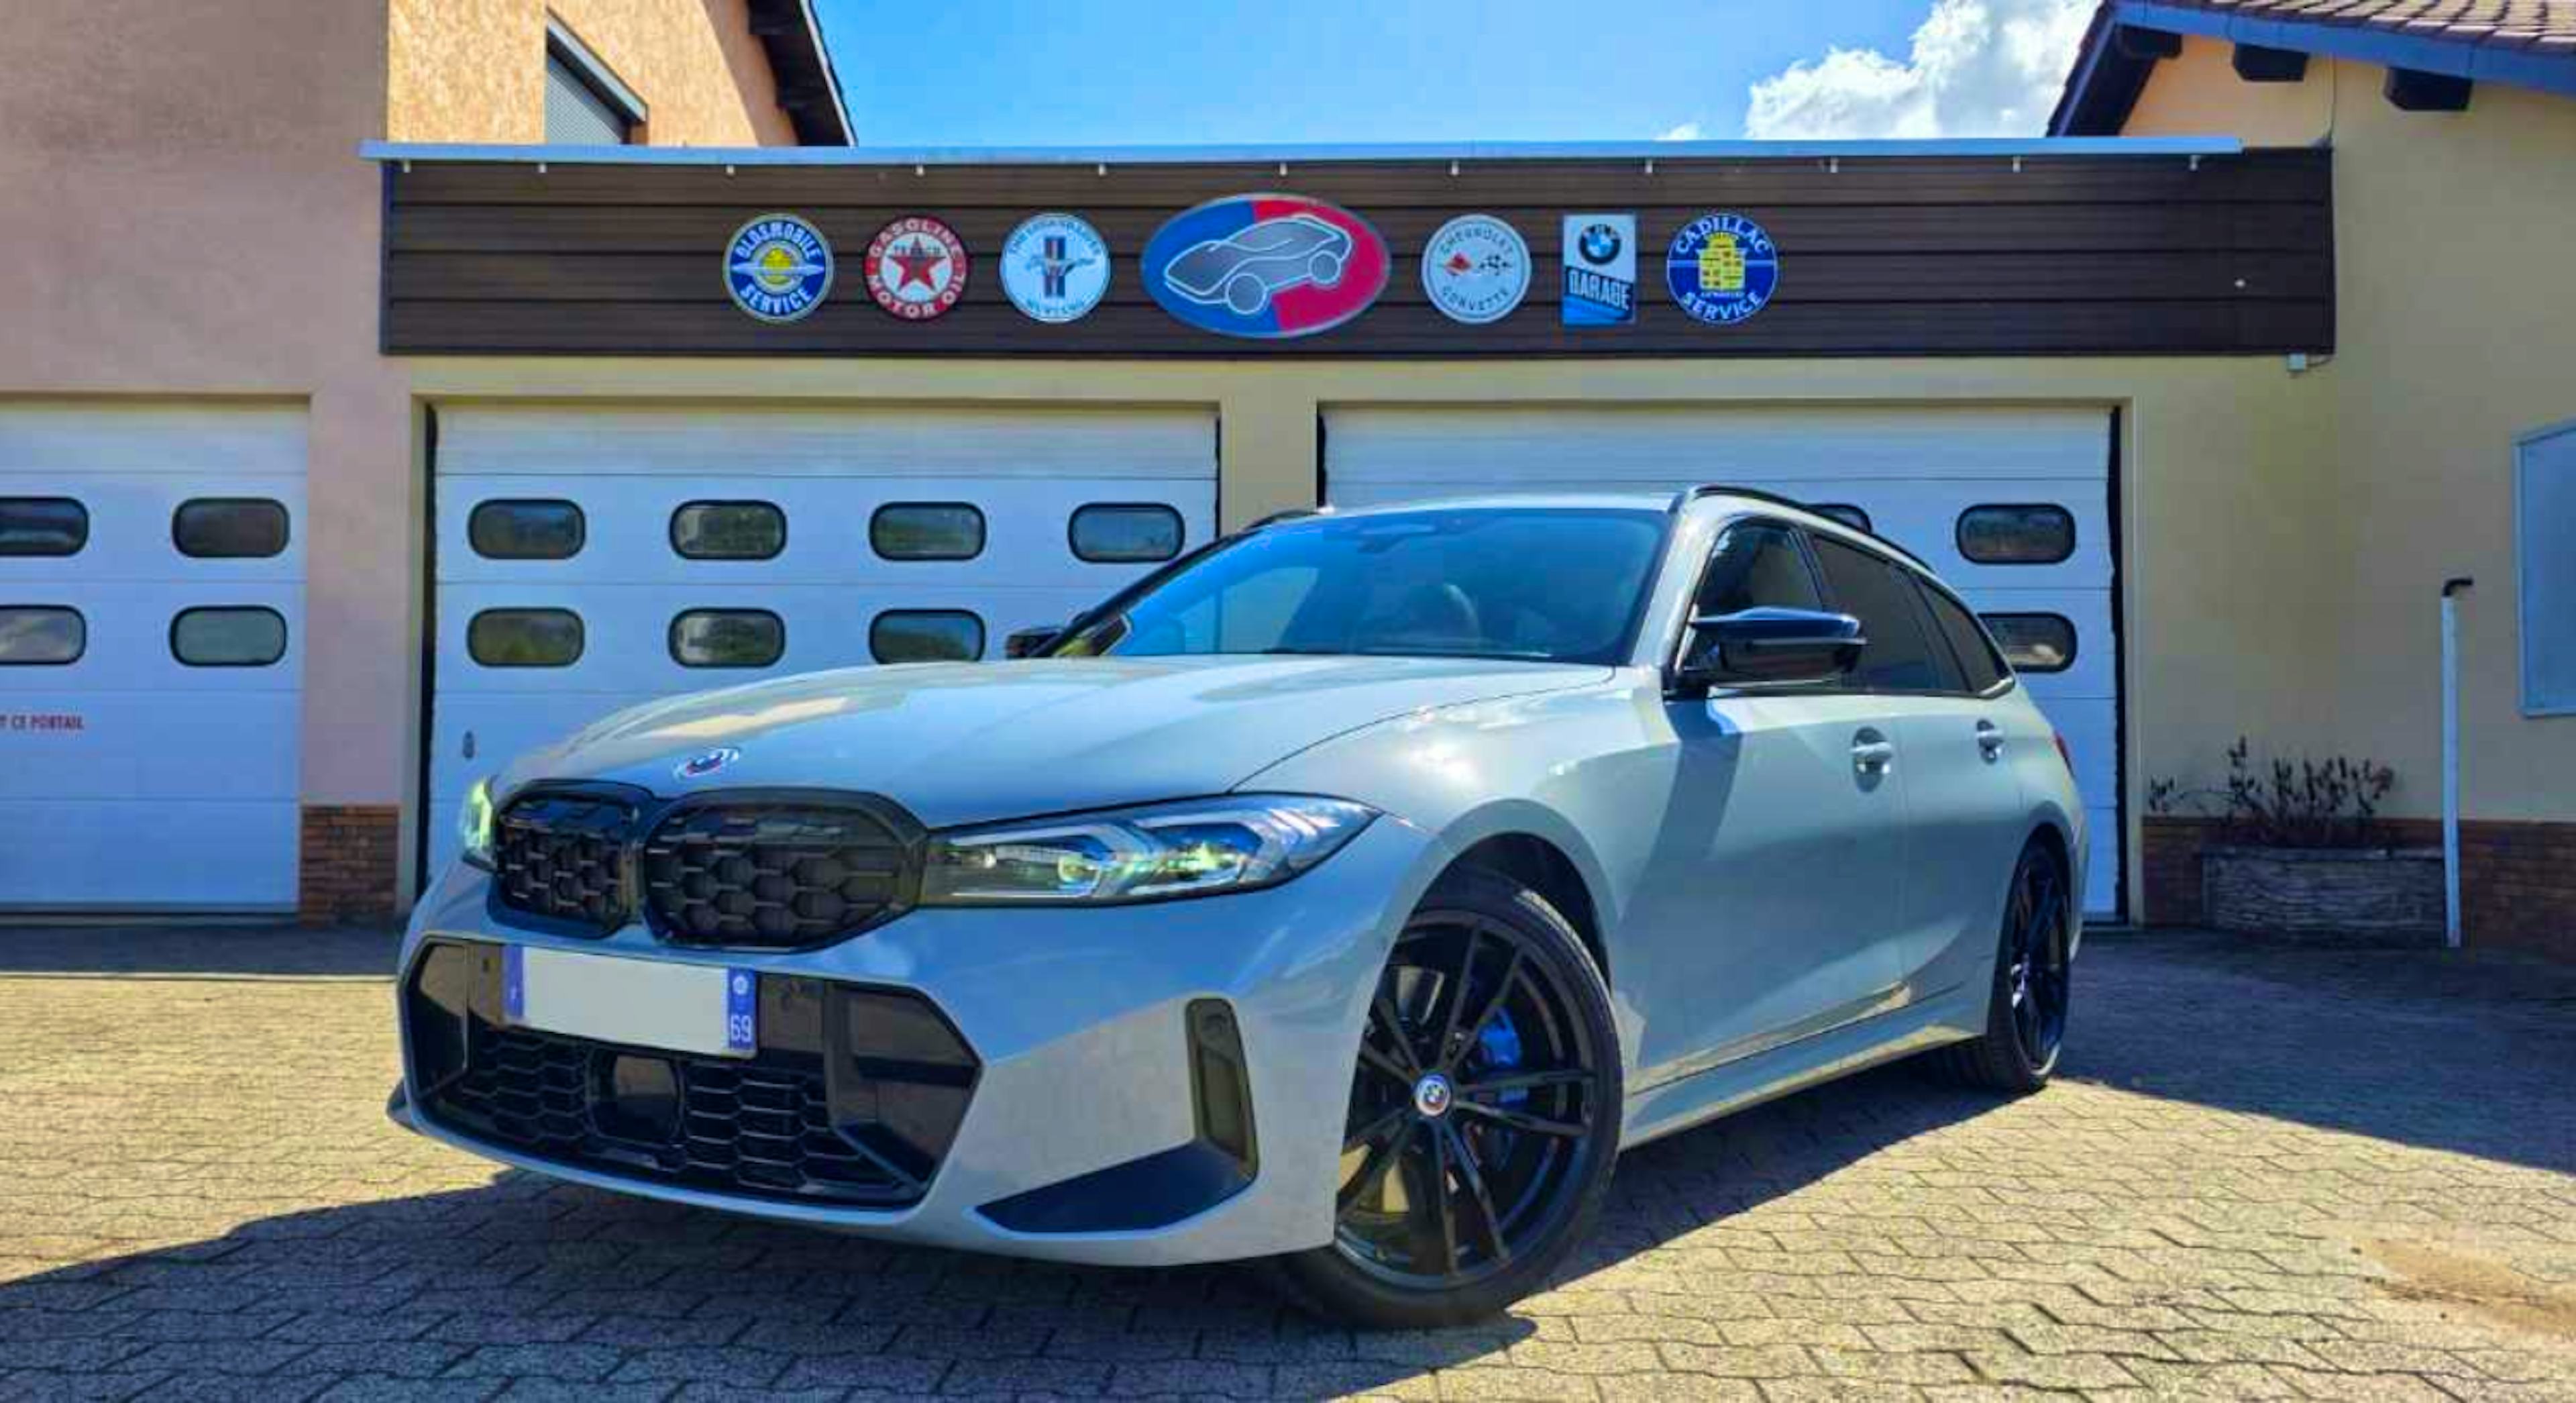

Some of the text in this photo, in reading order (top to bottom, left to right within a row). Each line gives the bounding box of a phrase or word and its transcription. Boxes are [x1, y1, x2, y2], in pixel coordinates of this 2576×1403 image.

[735, 222, 822, 260] OLDSMOBILE
[868, 217, 965, 258] GASOLINE
[1676, 217, 1769, 253] CADILLAC
[740, 283, 813, 313] SERVICE
[867, 274, 966, 319] MOTOR OIL
[1569, 268, 1631, 311] GARAGE
[1683, 291, 1762, 319] SERVICE
[12, 715, 26, 730] CE
[32, 715, 85, 730] PORTAIL
[731, 1015, 751, 1043] 69
